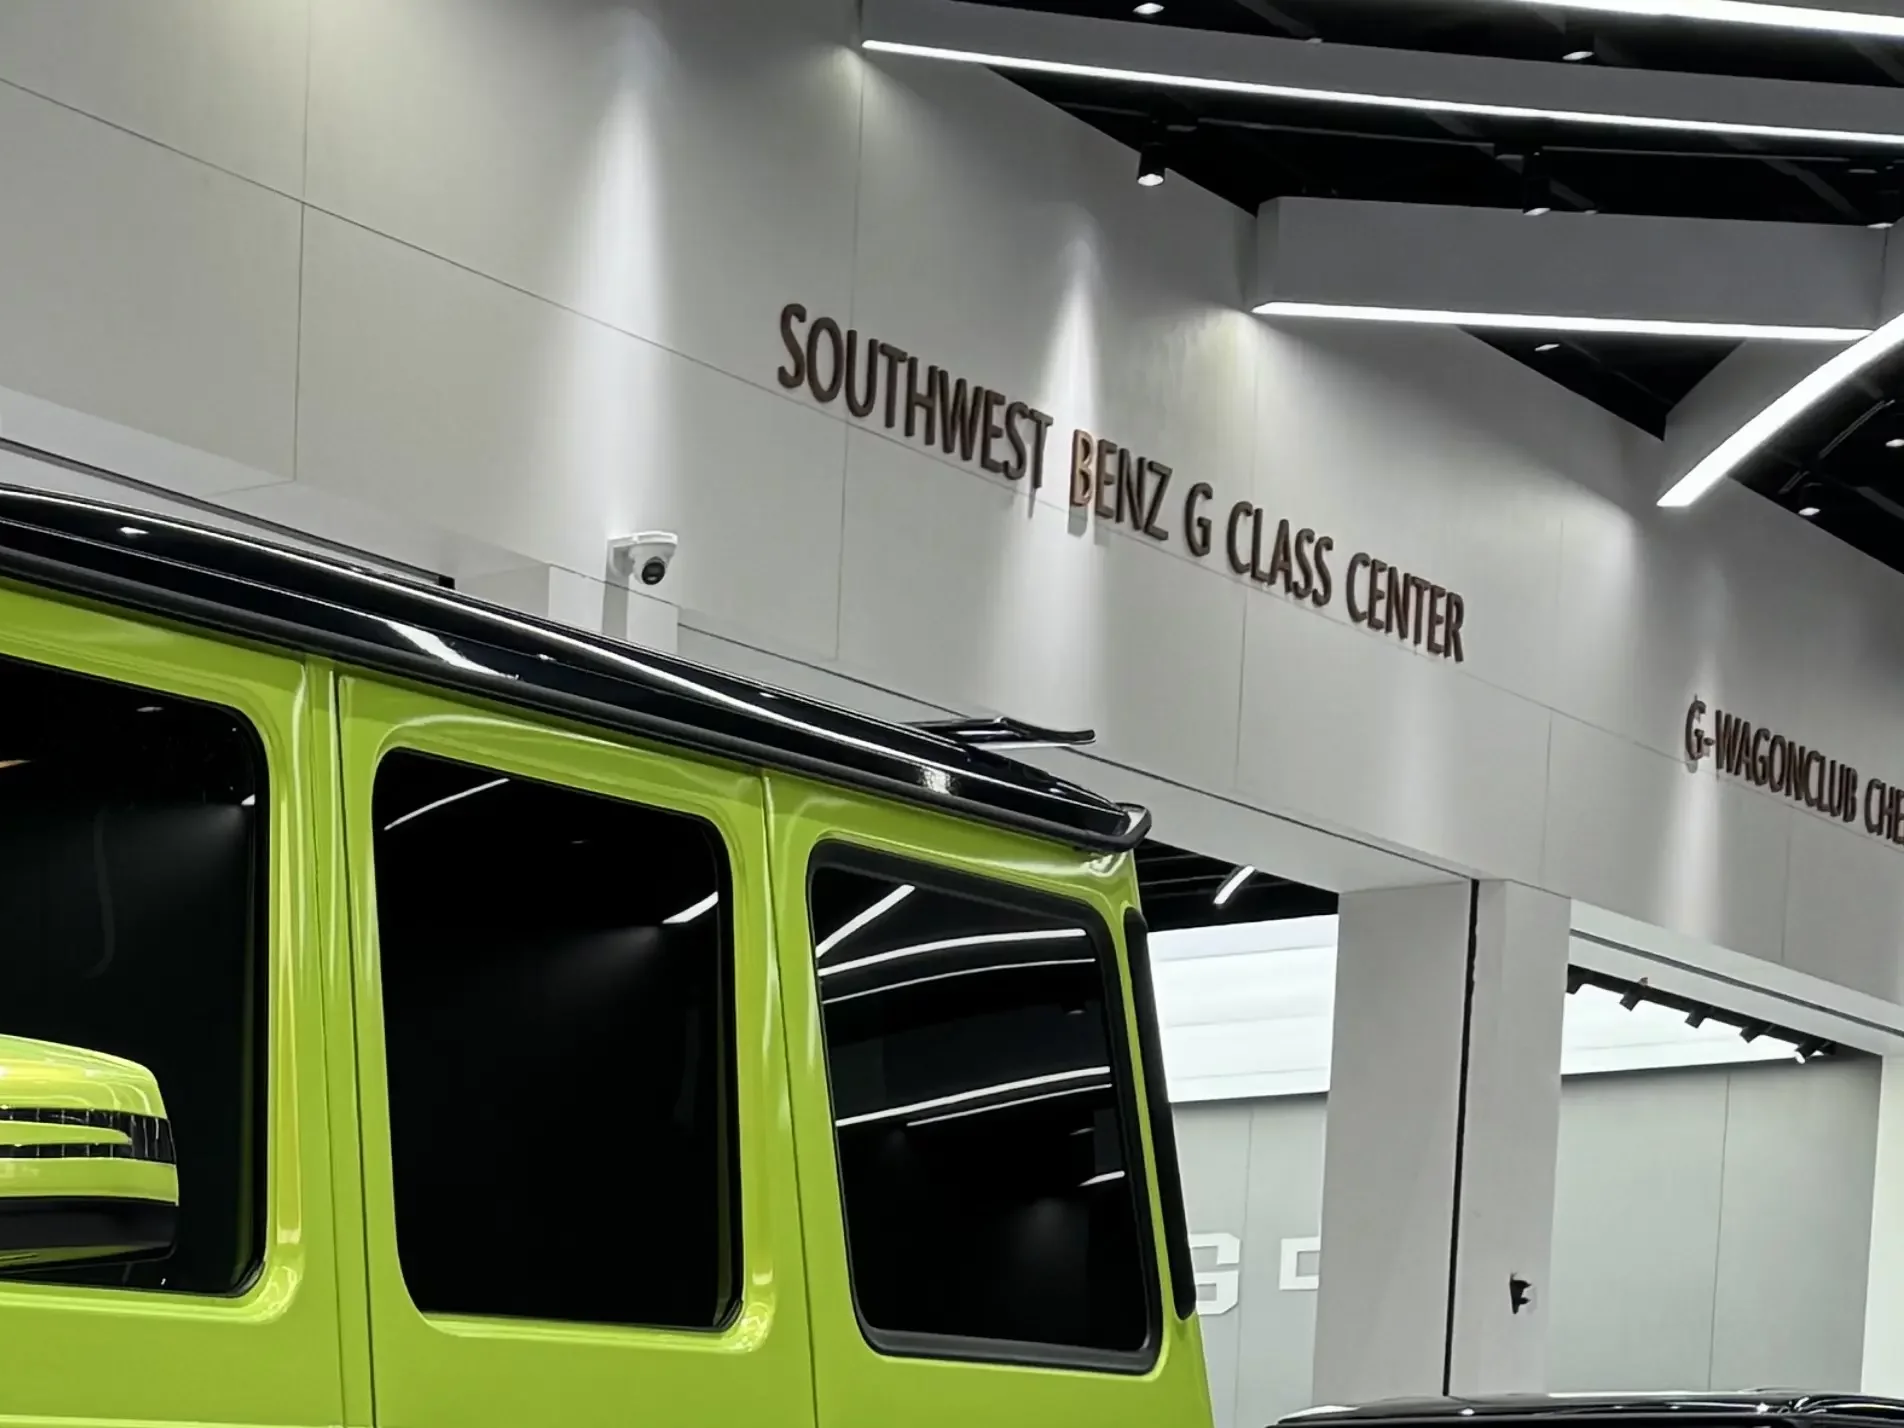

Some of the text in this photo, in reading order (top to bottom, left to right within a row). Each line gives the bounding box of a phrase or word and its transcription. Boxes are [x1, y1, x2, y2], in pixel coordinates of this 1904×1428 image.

[777, 302, 1465, 663] SOUTHWEST BENZ G CLASS CENTER
